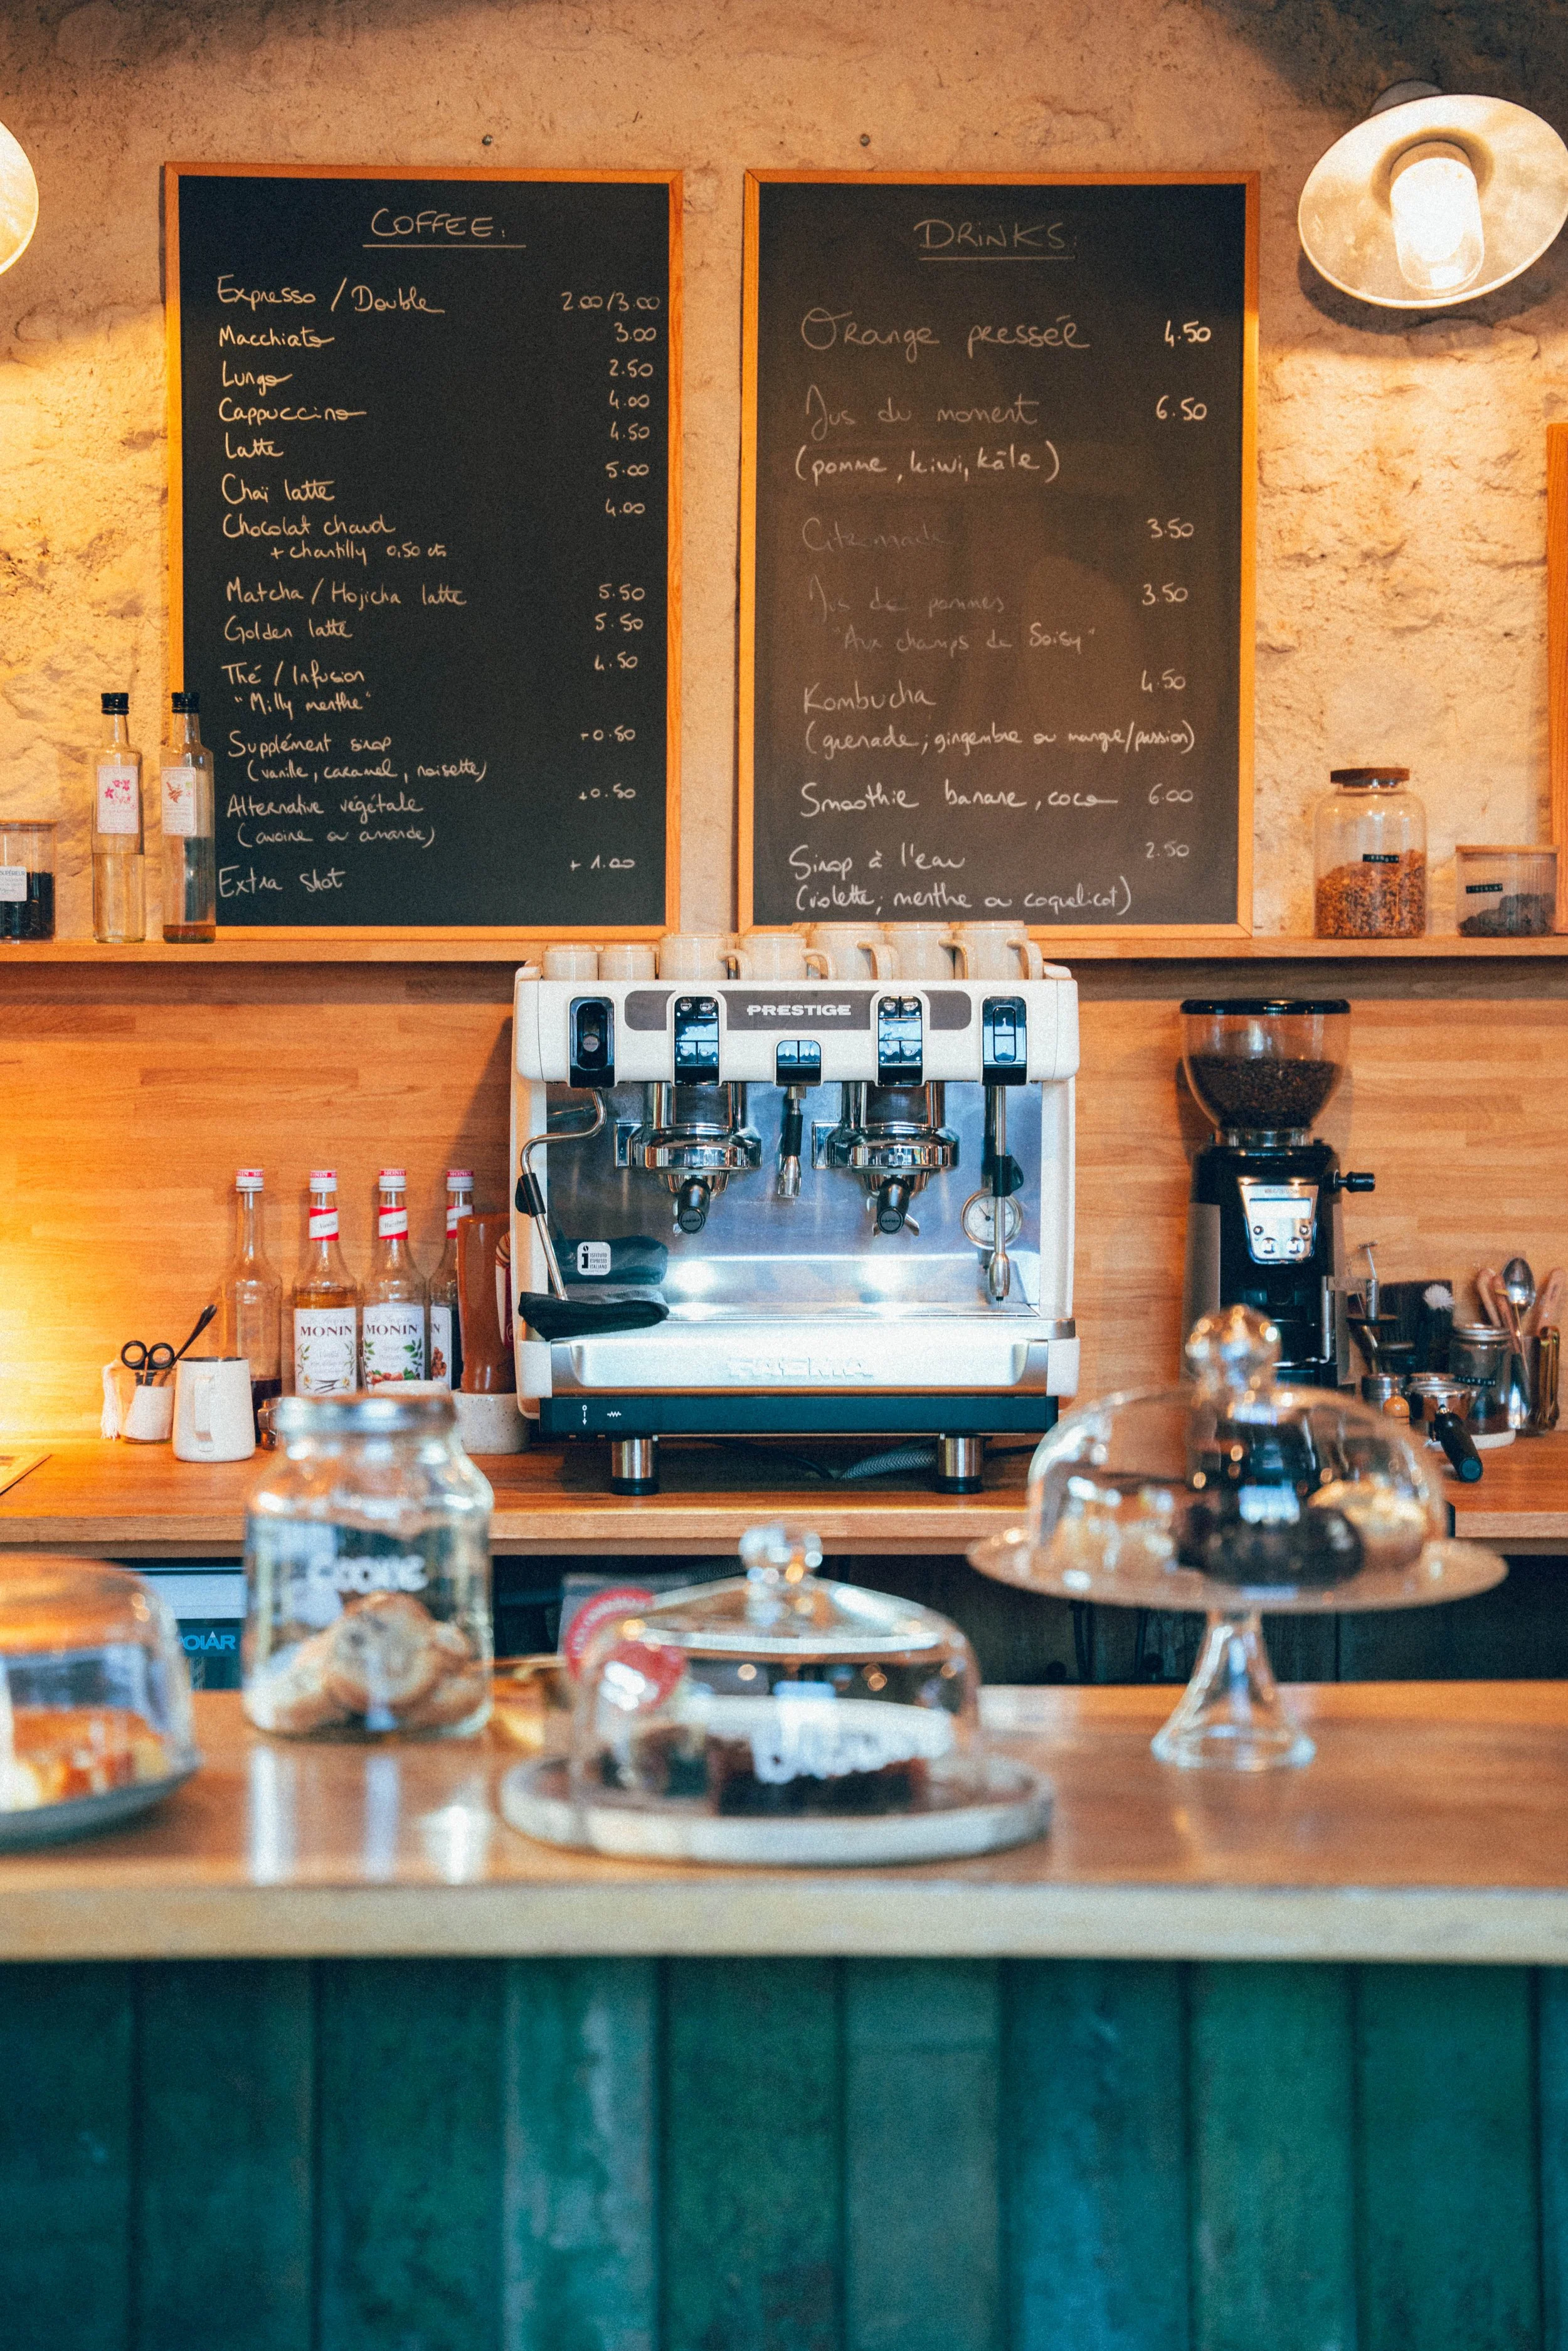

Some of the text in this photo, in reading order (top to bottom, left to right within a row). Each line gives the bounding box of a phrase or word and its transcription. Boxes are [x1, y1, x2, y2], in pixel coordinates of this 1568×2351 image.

[217, 273, 316, 311] Expresso
[219, 322, 657, 348] Macchiato 3.00
[800, 307, 1212, 364] Orange pressée 4.50
[223, 358, 654, 396] Lungo 2.50
[218, 389, 650, 426] Cappuccino 4.00
[806, 384, 1208, 442] Jus du moment 6.50
[225, 421, 650, 459] Latte 4.50
[285, 478, 336, 502] latte
[605, 460, 650, 479] 5.00
[223, 498, 645, 538] Chocolat chaud 4.00
[1147, 517, 1194, 539] 3.50
[226, 576, 304, 603] Matcha
[331, 580, 401, 611] Hojicha
[422, 583, 467, 606] latte
[598, 583, 645, 601] 5.50
[869, 586, 906, 612] de
[928, 595, 1005, 618] pommes
[1142, 582, 1189, 607] 3.50
[224, 612, 644, 644] Golden latte 5.50
[896, 628, 970, 658] champs
[221, 662, 262, 685] Thé
[293, 659, 365, 689] Infusion
[594, 651, 638, 671] 4.50
[803, 669, 1187, 714] Kombucha 4.50
[228, 730, 332, 759] Supplément
[934, 721, 1023, 756] gingembre
[1033, 733, 1057, 746] ou
[226, 793, 324, 818] Alternative
[340, 791, 424, 825] végétale
[800, 782, 919, 817] Smoothie
[1047, 791, 1119, 807] coco
[1148, 783, 1194, 806] 6.00
[326, 831, 349, 842] ou
[788, 841, 1190, 881] Sirop à l'eau 2.50
[218, 864, 283, 898] Extra
[893, 882, 973, 908] menthe
[984, 896, 1013, 908] ou
[746, 1004, 851, 1016] PRESTIGE
[300, 1325, 352, 1337] MONIN
[366, 1324, 418, 1336] MONIN
